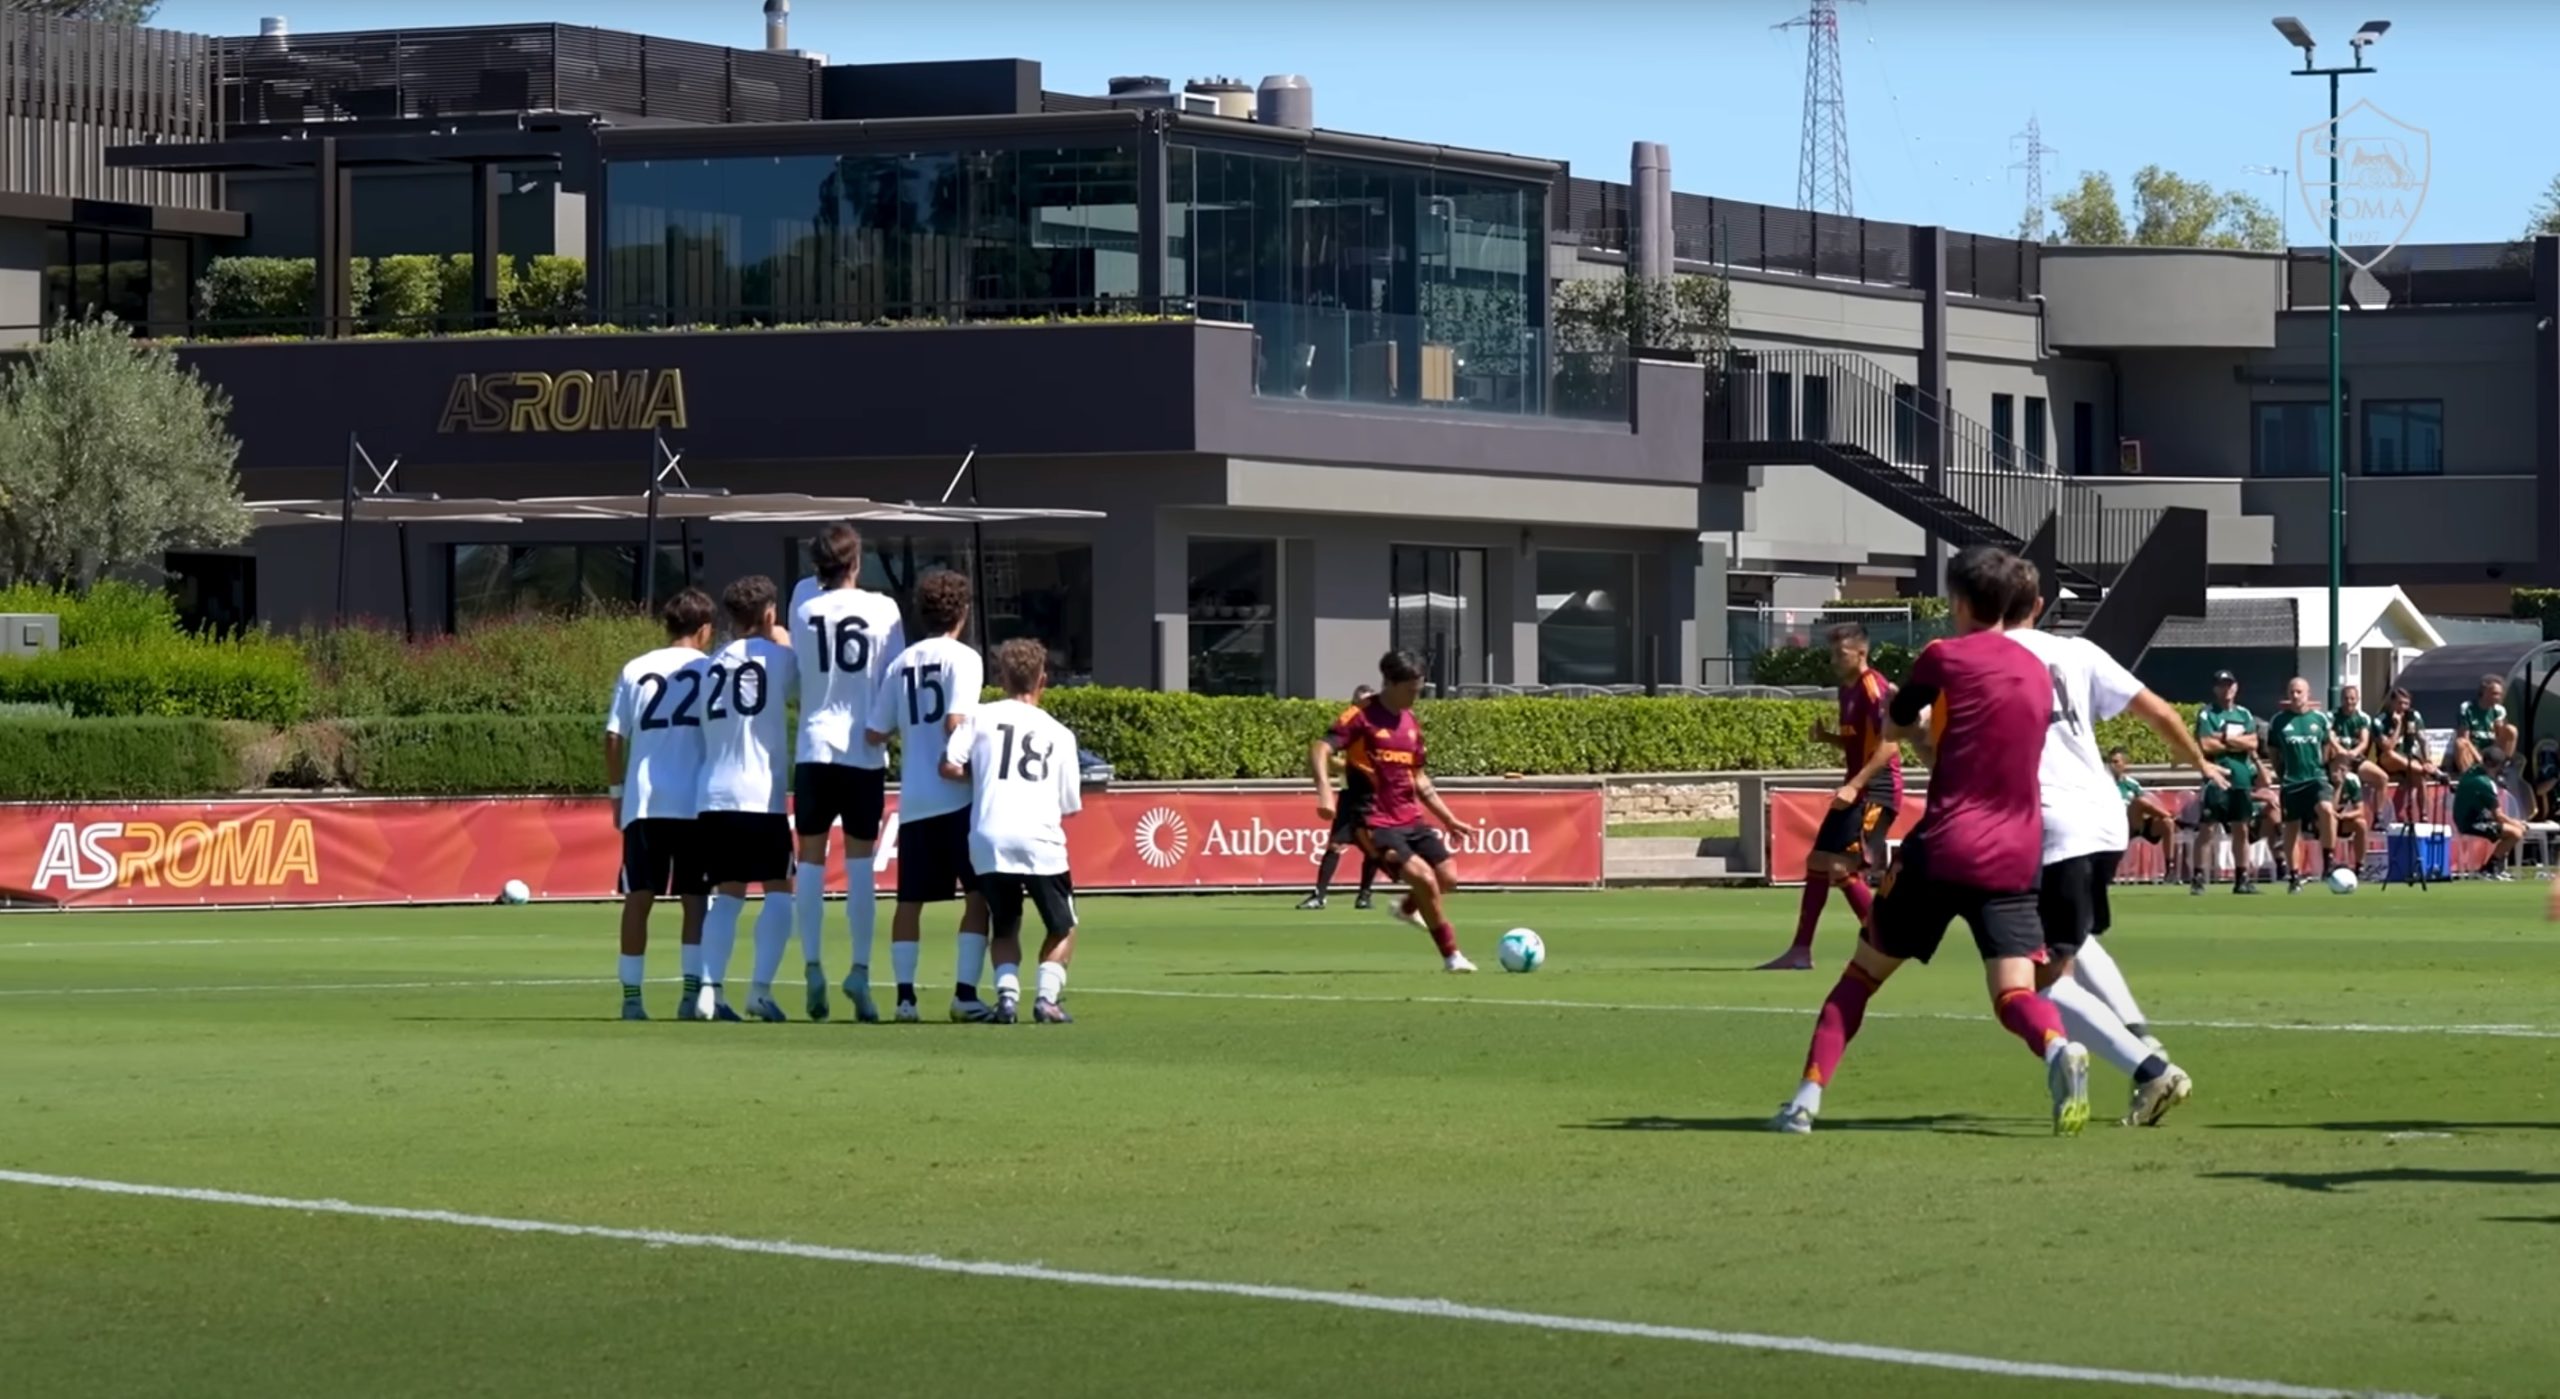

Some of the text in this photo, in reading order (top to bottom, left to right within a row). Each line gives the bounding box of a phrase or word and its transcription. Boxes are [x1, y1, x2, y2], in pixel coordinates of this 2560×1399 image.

[808, 615, 870, 674] 16
[638, 670, 701, 731] 22
[707, 660, 768, 718] 20
[901, 664, 945, 726] 15
[996, 723, 1054, 782] 18
[1201, 817, 1340, 865] Auberg
